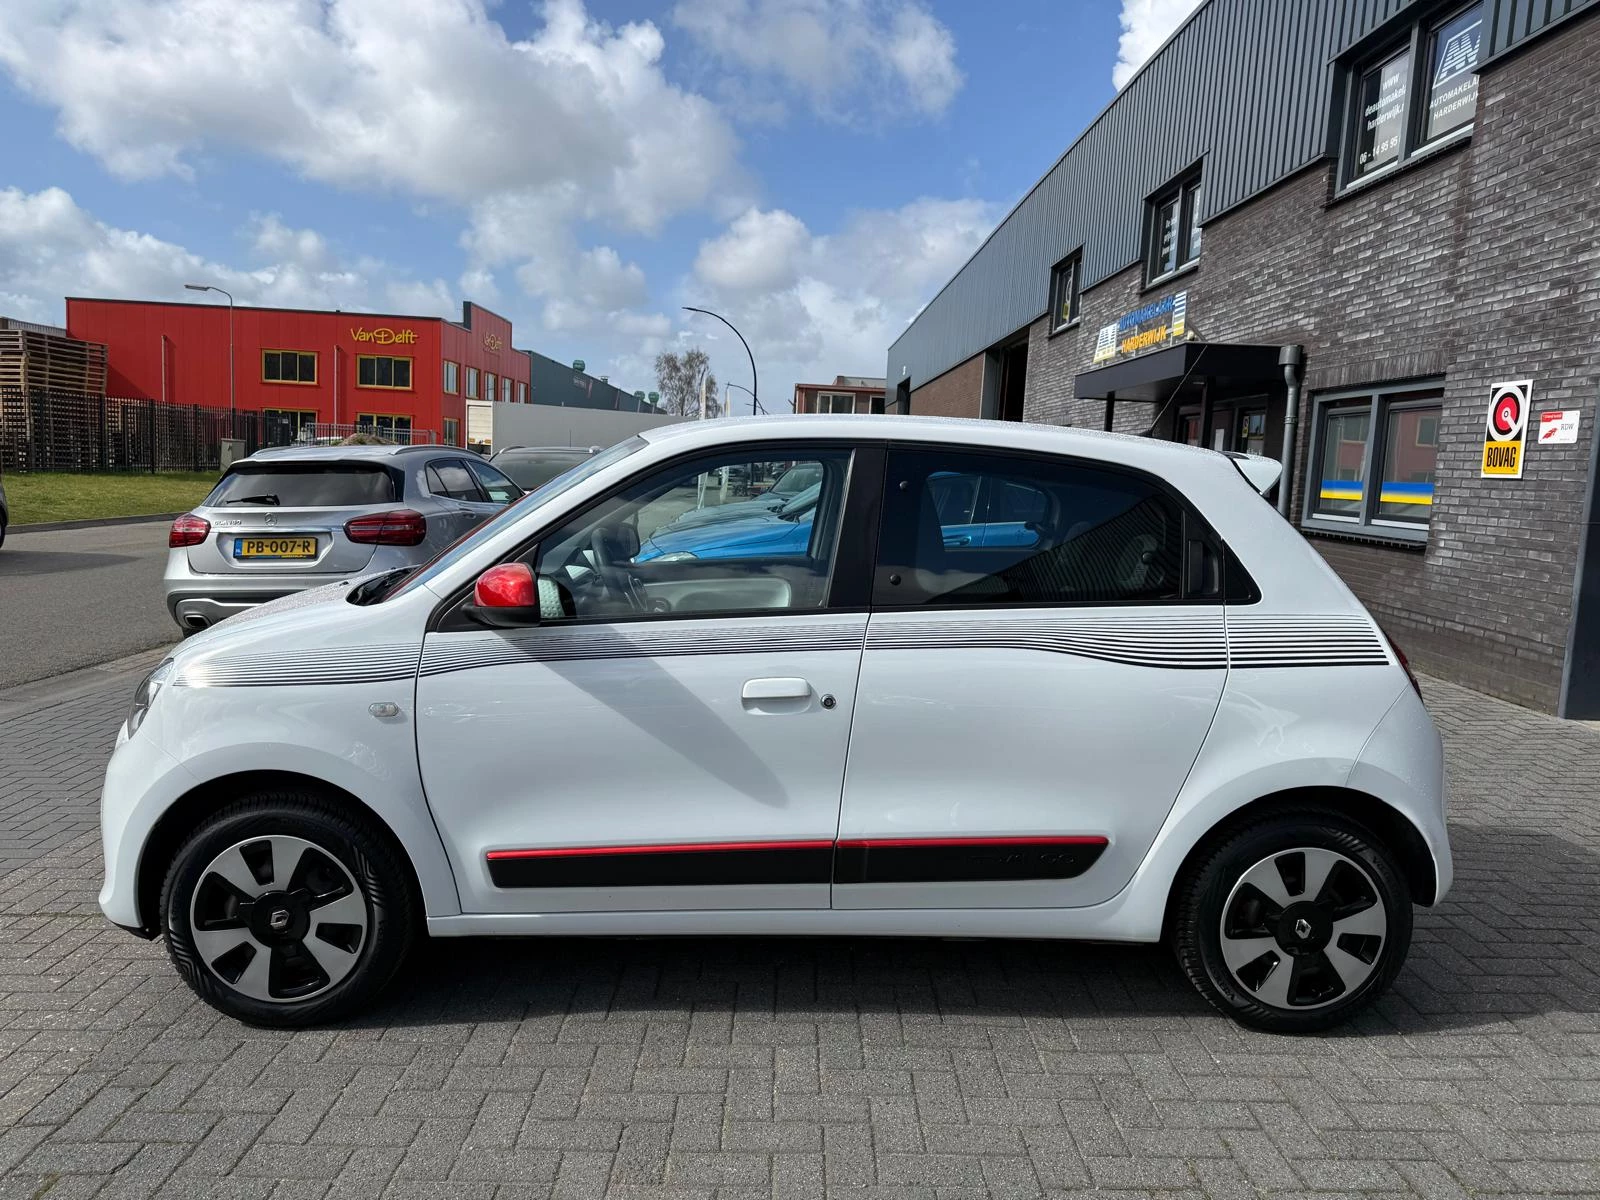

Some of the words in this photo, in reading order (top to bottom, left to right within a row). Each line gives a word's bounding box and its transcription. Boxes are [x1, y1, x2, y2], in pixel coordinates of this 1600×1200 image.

[1383, 73, 1400, 91] www
[1360, 152, 1367, 164] 06
[1121, 325, 1167, 353] HARDERWIJK
[1486, 446, 1517, 468] BOVAG
[247, 541, 310, 553] PB-007-R
